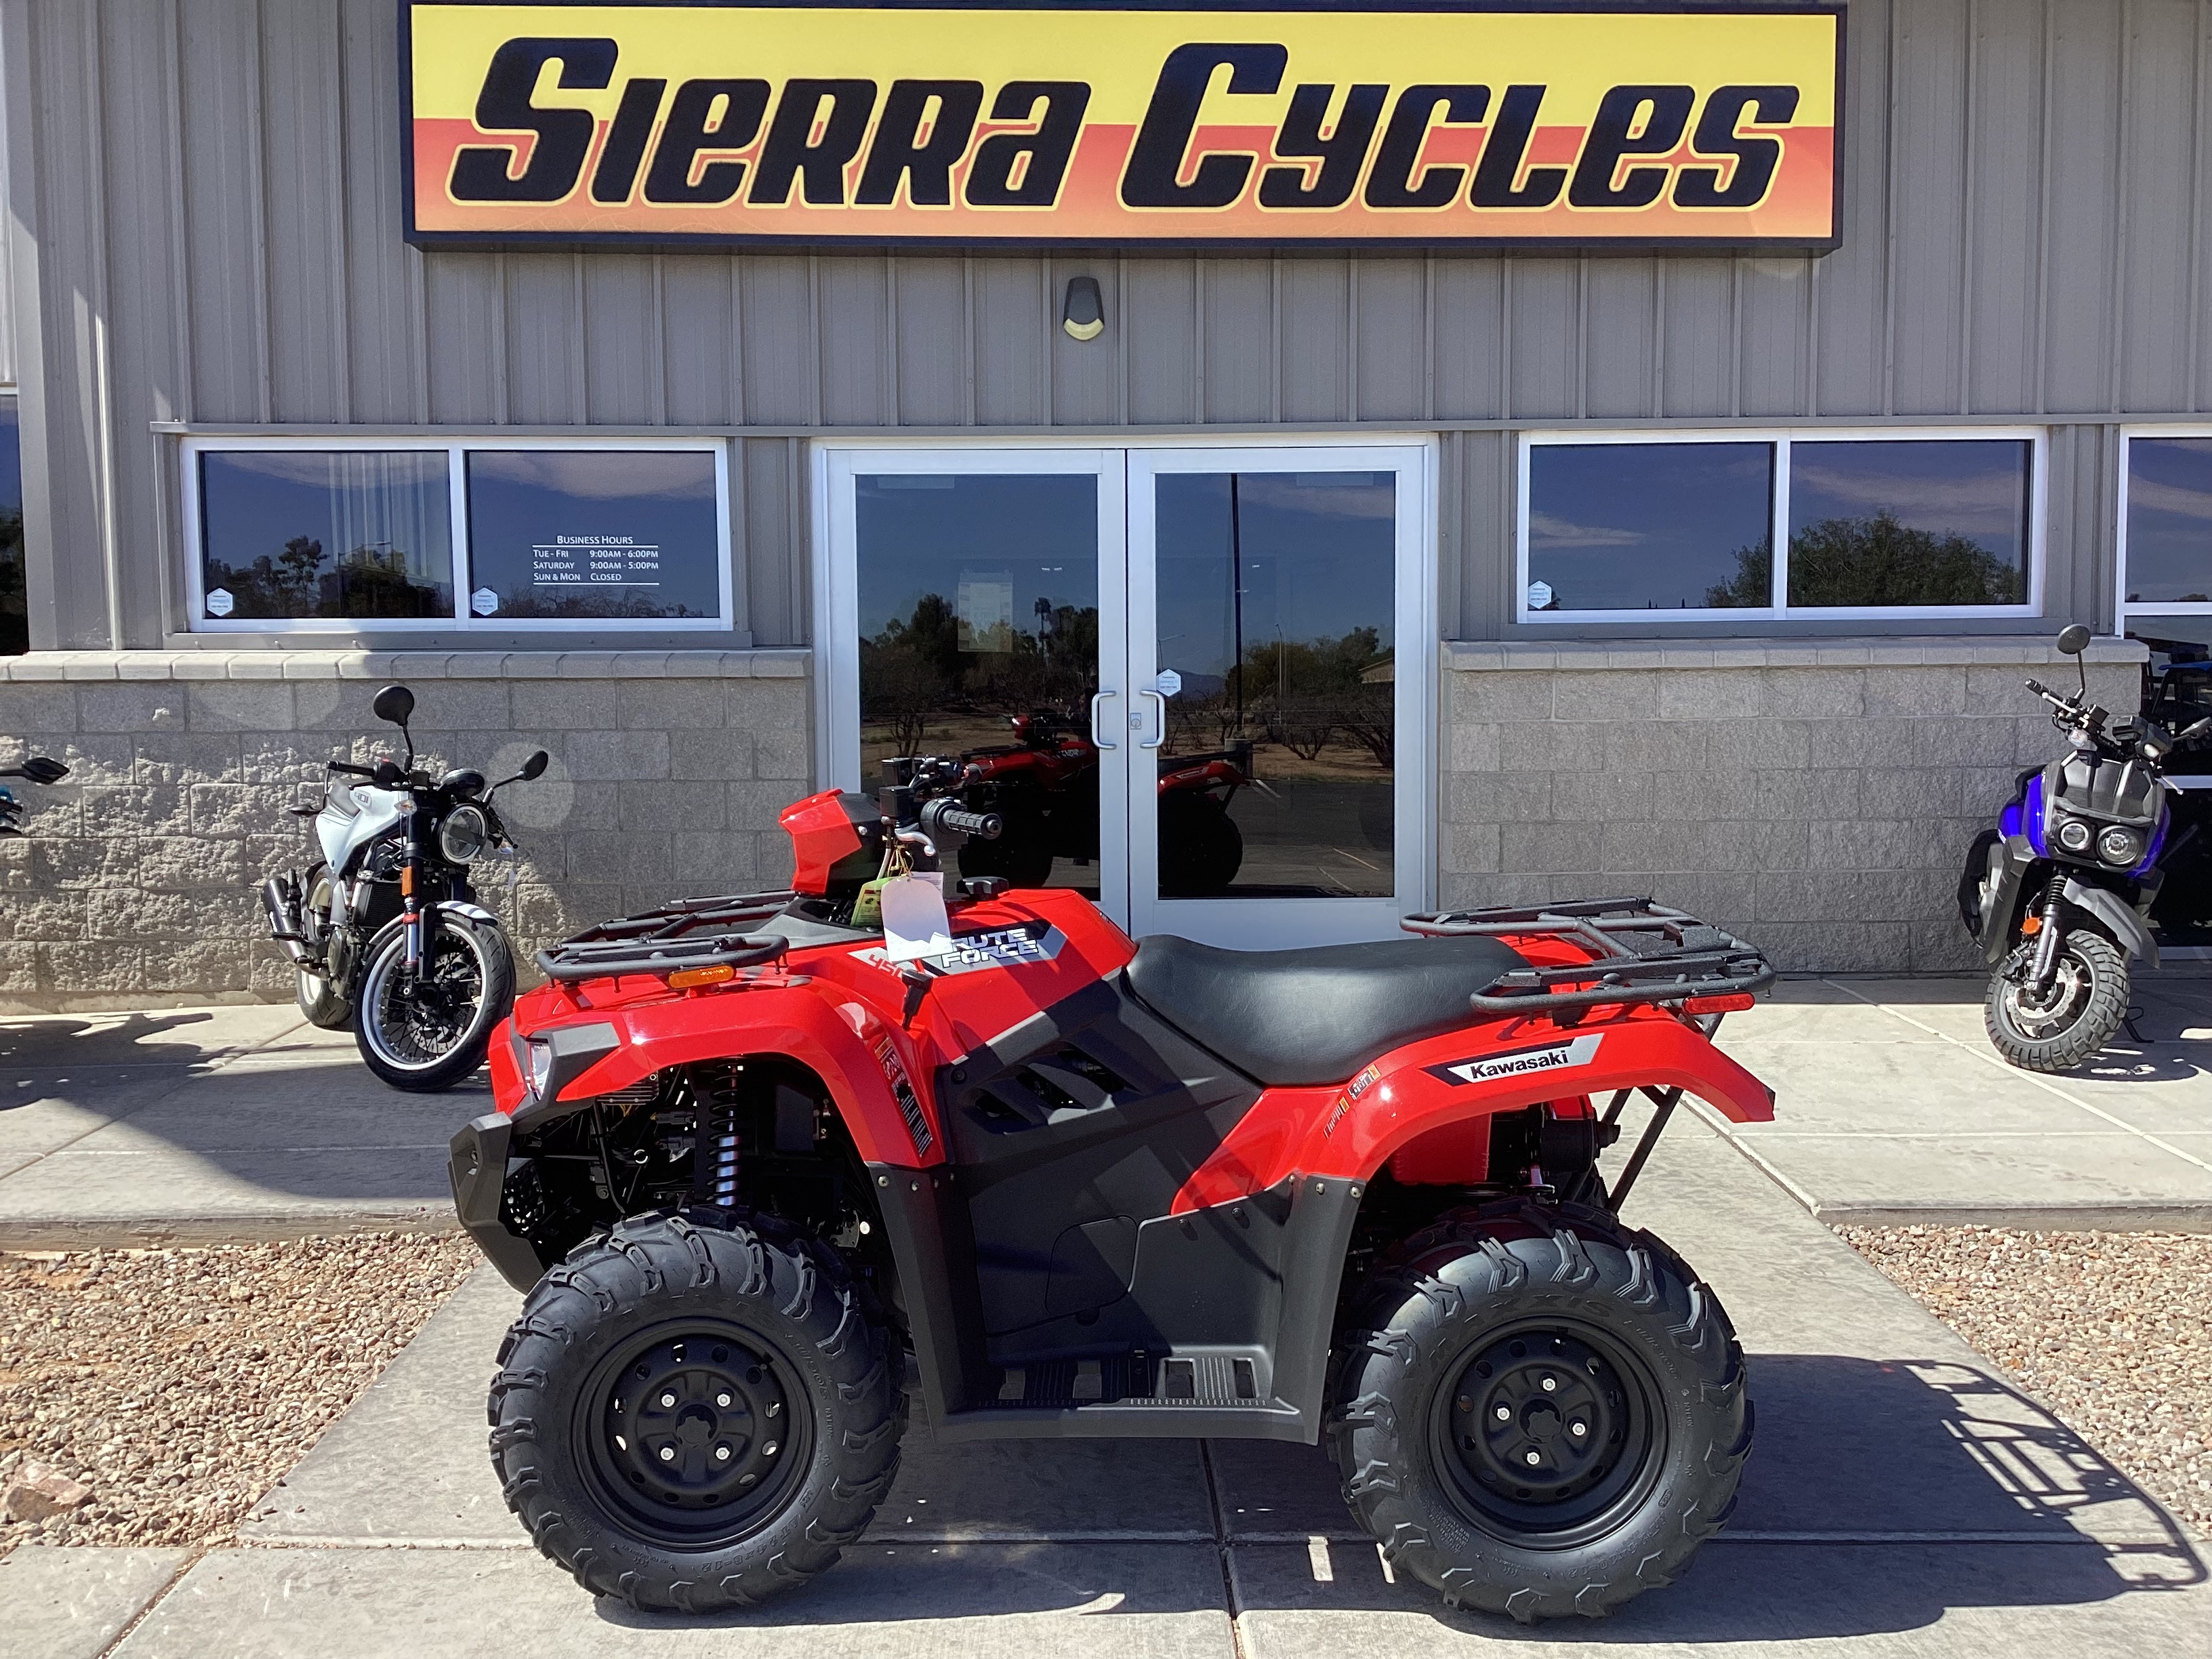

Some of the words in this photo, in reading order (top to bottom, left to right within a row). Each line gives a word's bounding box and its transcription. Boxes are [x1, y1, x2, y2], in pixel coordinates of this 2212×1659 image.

[556, 535, 599, 544] BUSINESS
[601, 535, 633, 544] HOURS
[533, 550, 549, 558] TUE
[556, 550, 569, 558] FRI
[590, 550, 621, 558] 9:00AM
[628, 550, 659, 558] 6:00PM
[533, 561, 575, 569] SATURDAY
[533, 573, 551, 581] SUN
[590, 573, 621, 581] CLOSED
[951, 928, 1027, 952] RUTE
[941, 939, 1040, 969] FORCE
[1470, 1050, 1569, 1079] Kawasaki
